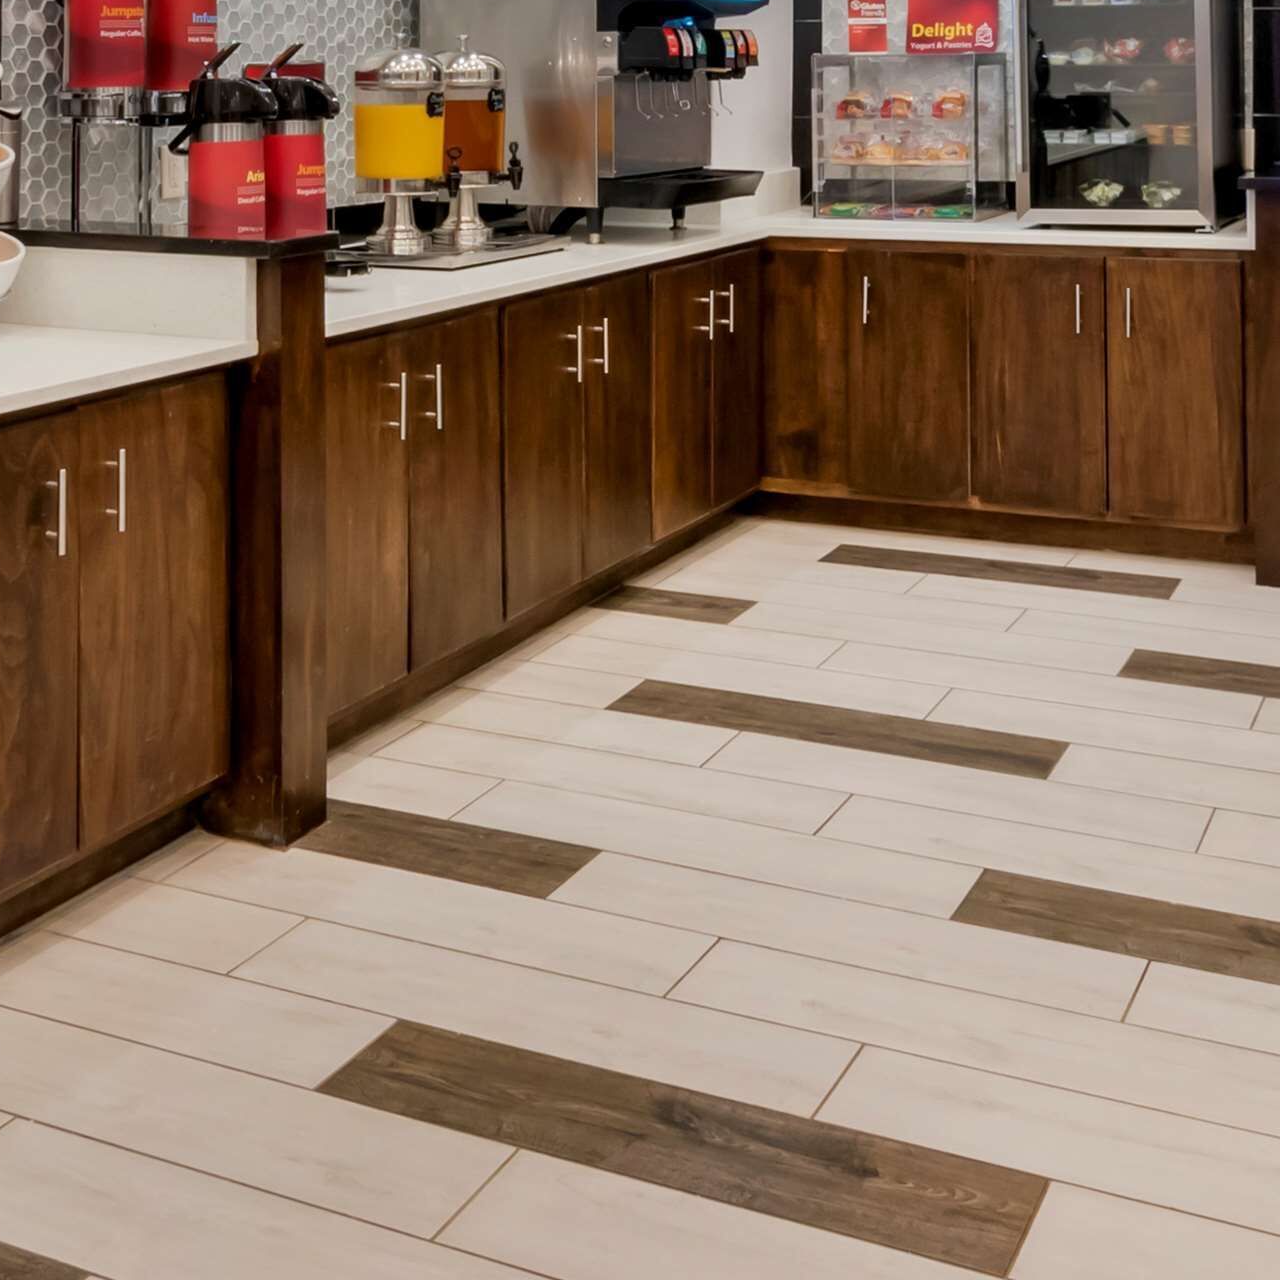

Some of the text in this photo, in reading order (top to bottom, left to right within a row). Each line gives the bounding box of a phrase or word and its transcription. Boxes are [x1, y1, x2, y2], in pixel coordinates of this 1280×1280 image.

[912, 22, 974, 40] Delight
[910, 41, 972, 51] Yogurt & Pastries
